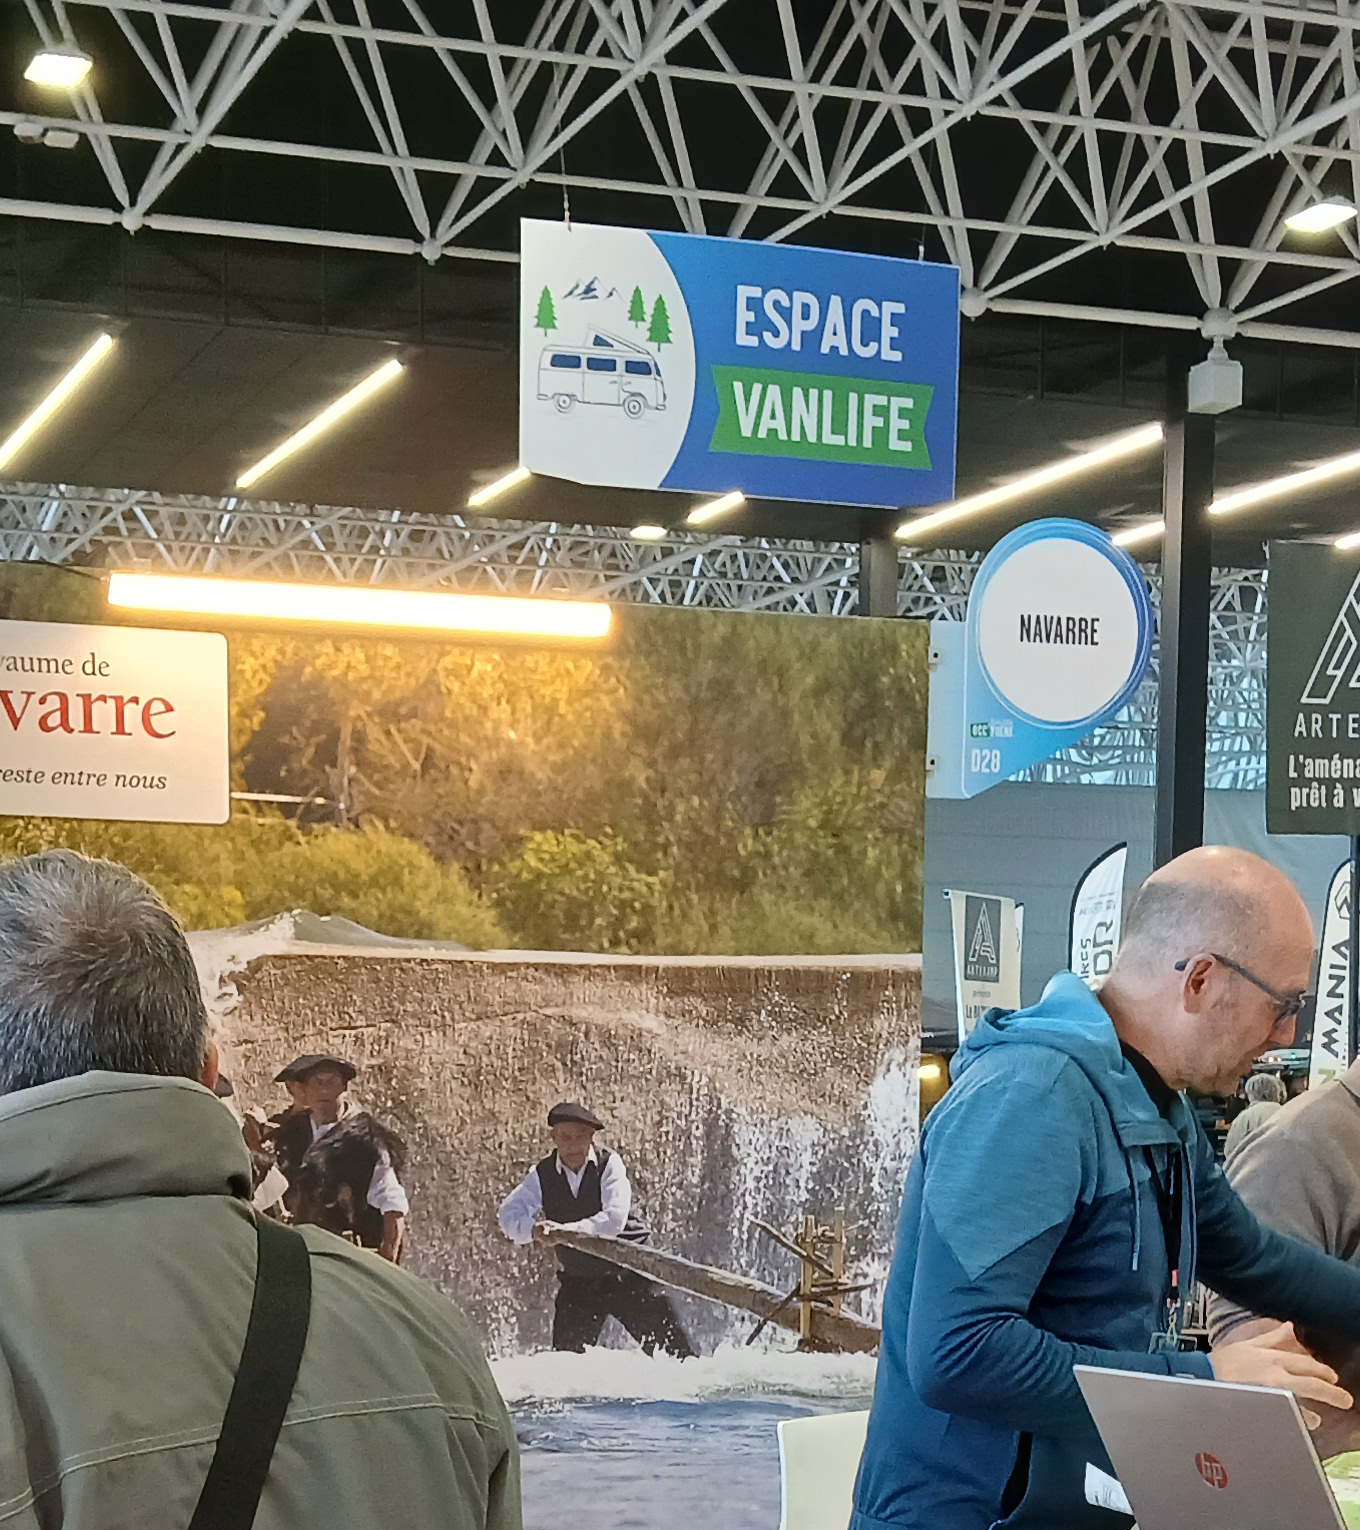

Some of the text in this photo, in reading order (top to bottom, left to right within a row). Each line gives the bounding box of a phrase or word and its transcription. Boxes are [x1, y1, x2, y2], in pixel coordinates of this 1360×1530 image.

[735, 285, 906, 362] ESPACE
[732, 380, 914, 452] VANLIFE
[1020, 614, 1100, 647] NAVARRE
[82, 652, 111, 677] de
[971, 749, 1001, 773] D28
[51, 769, 107, 787] entre
[114, 773, 167, 790] nous
[1291, 781, 1327, 811] prêt
[1333, 782, 1344, 808] à
[1201, 1453, 1223, 1489] hp
